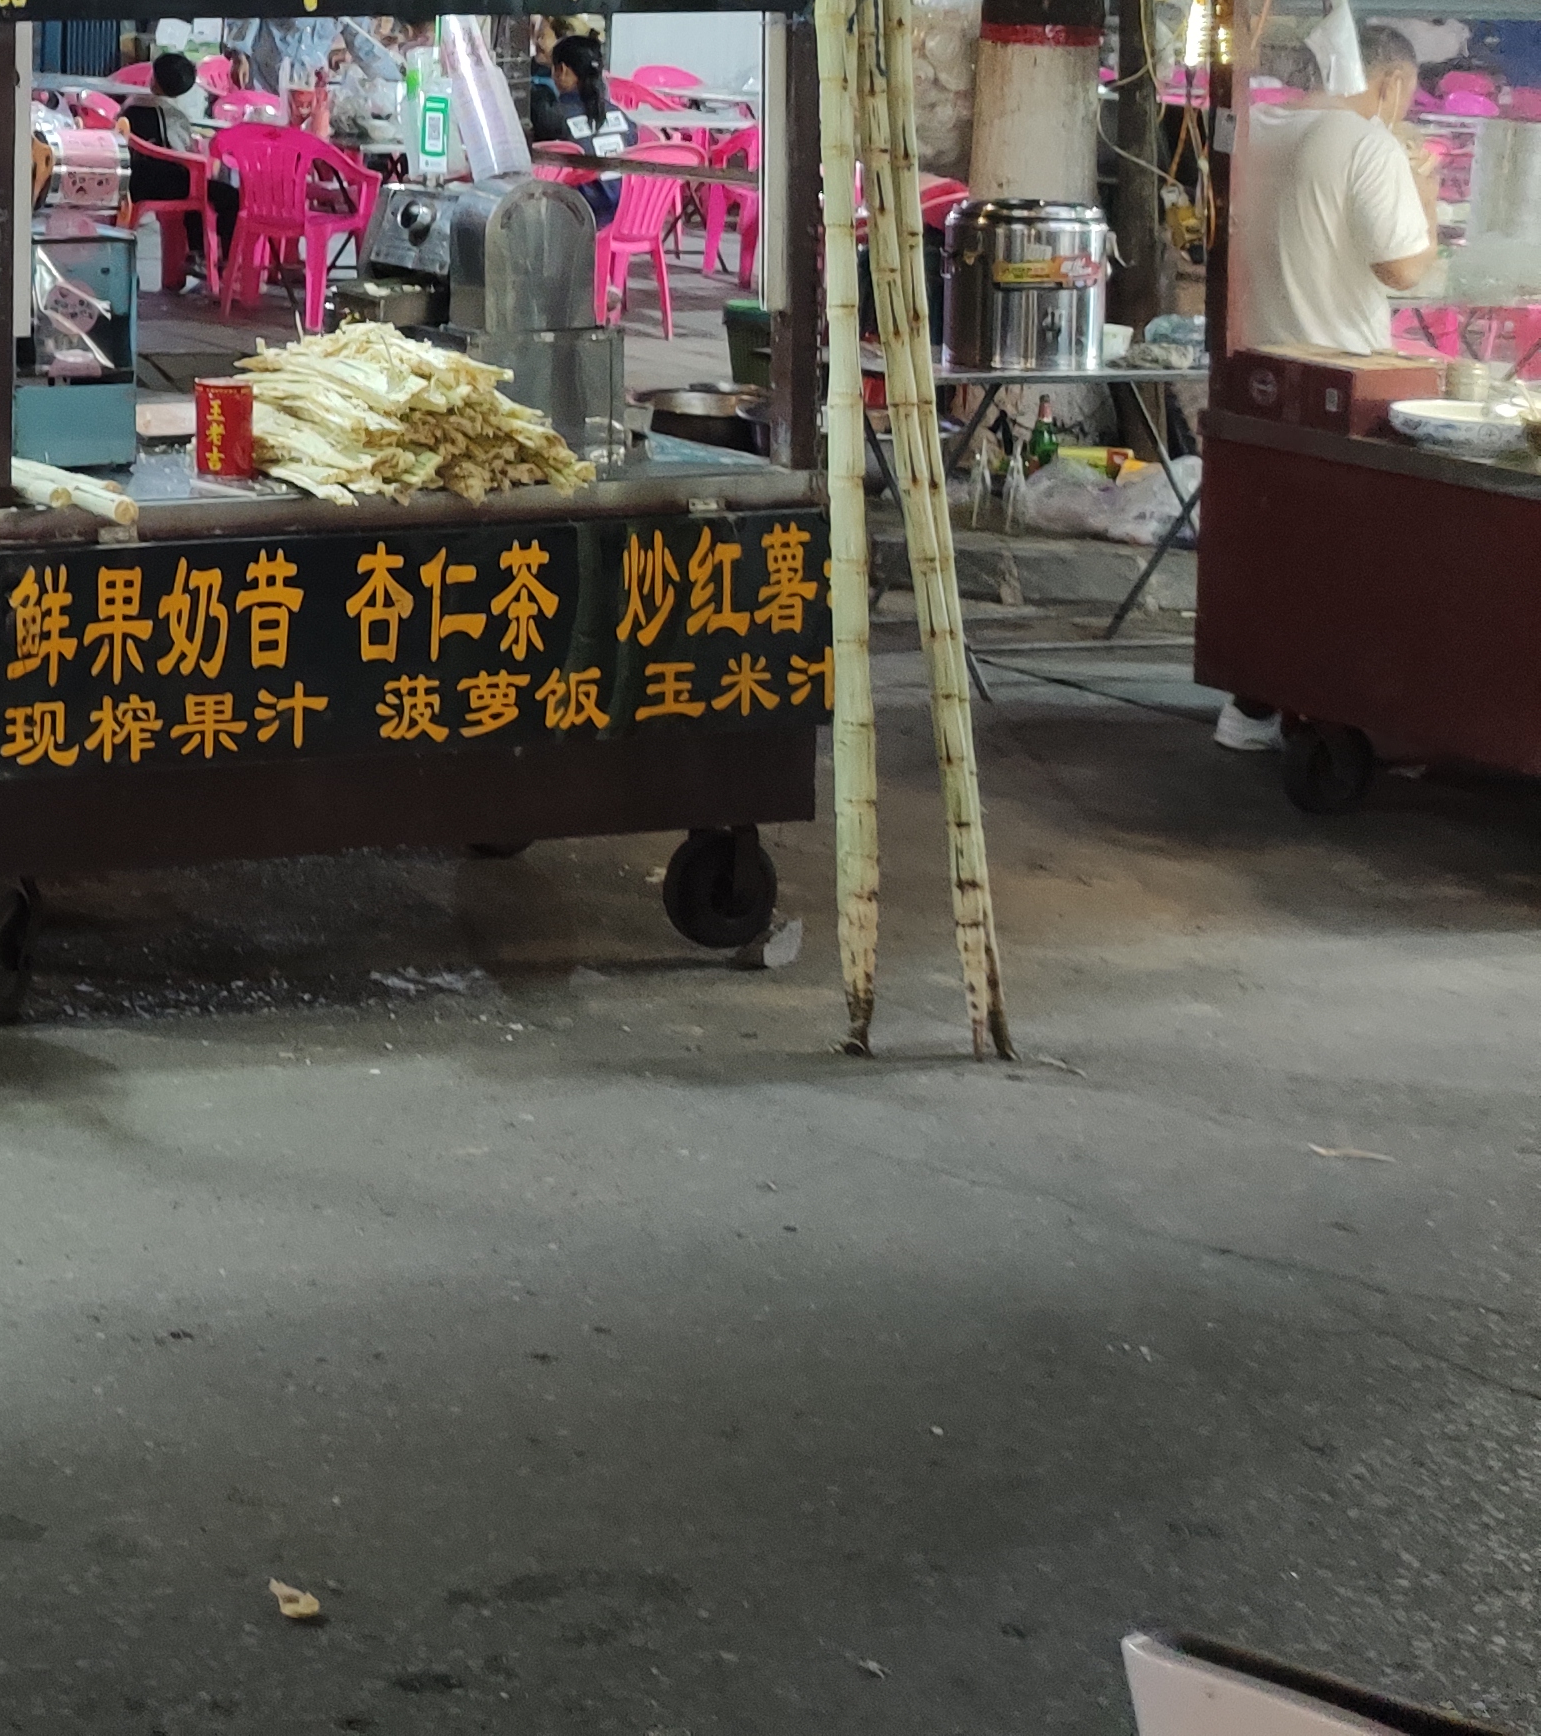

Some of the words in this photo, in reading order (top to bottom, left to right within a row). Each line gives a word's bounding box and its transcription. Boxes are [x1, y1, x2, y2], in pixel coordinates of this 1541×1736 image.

[205, 398, 226, 471] 王老吉
[6, 549, 305, 682] 鲜果奶昔
[345, 539, 559, 662] 杏仁茶
[616, 521, 834, 647] 炒红薯
[0, 682, 329, 766] 现榨果汁
[375, 667, 611, 743] 菠萝饭
[635, 646, 835, 721] 玉米汁
